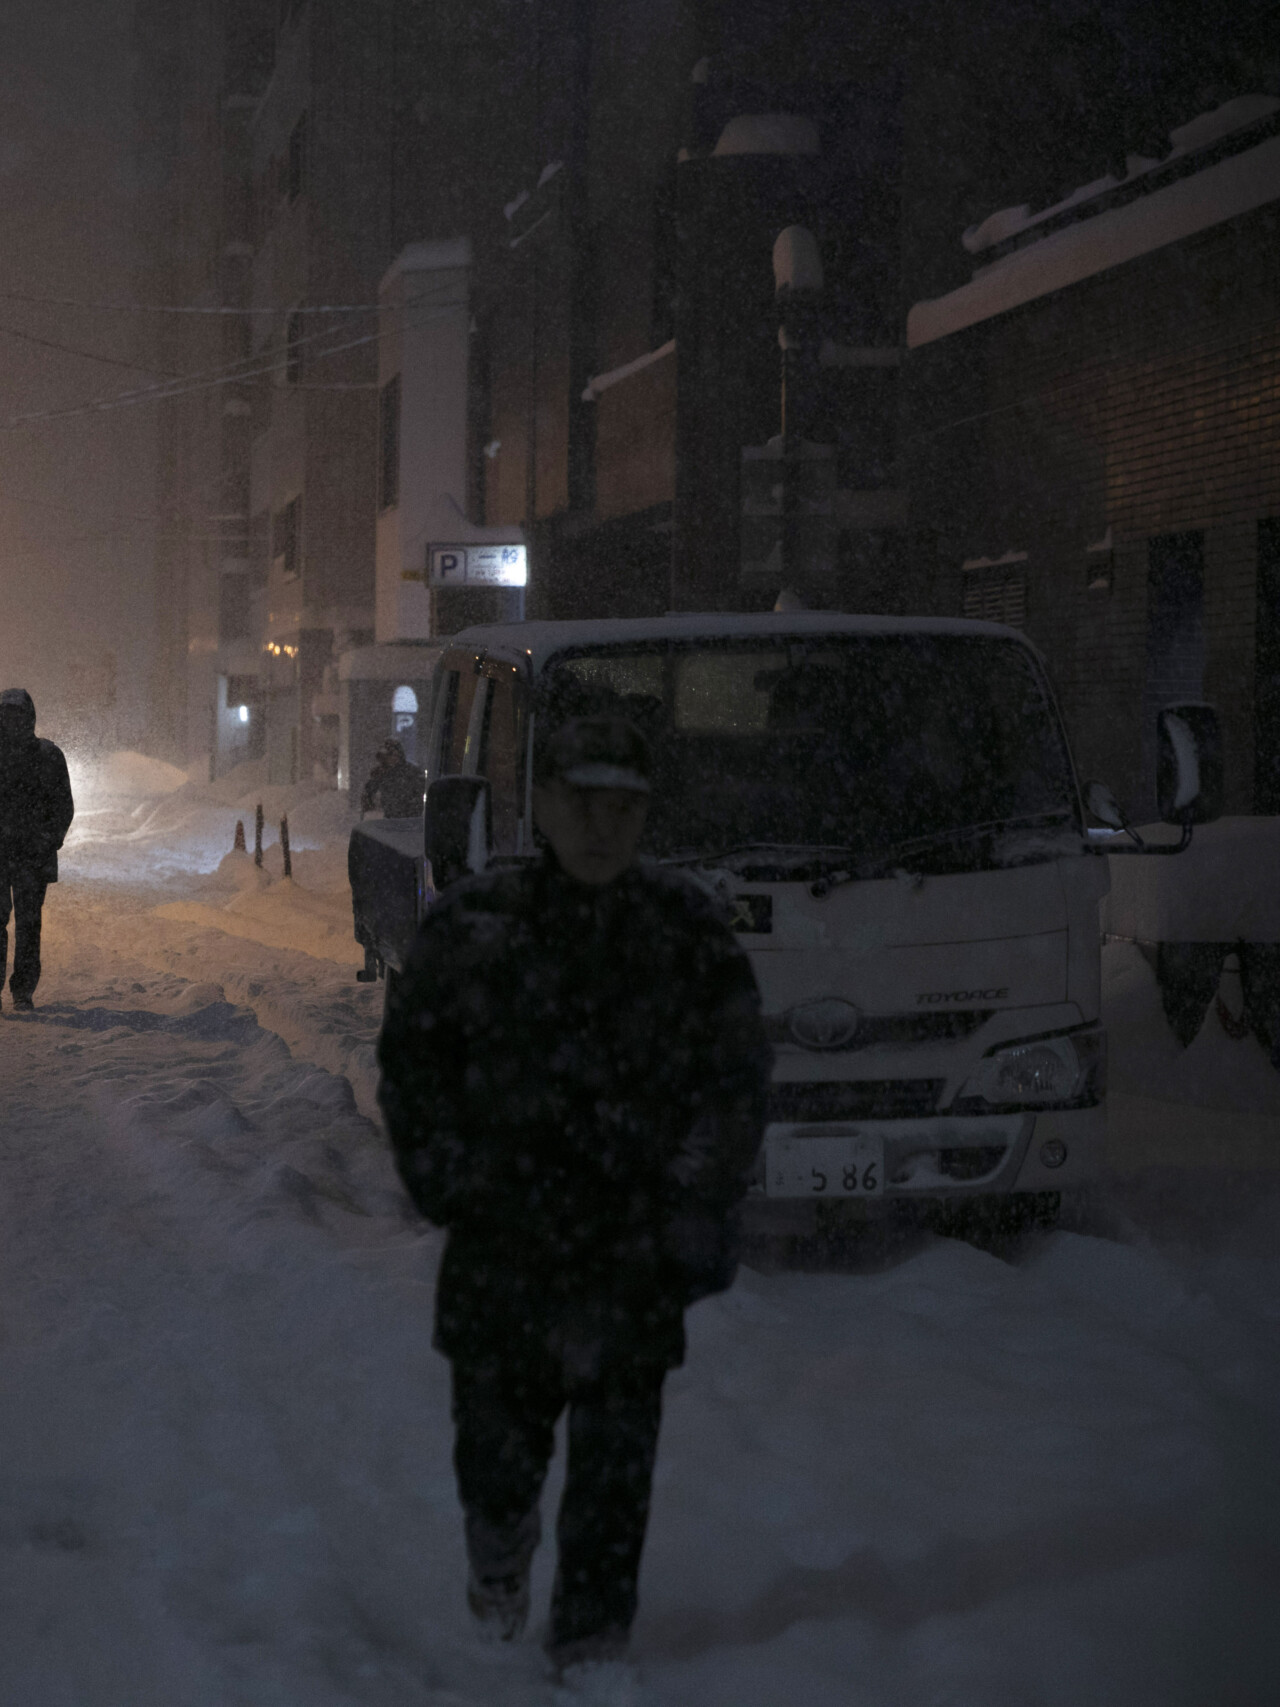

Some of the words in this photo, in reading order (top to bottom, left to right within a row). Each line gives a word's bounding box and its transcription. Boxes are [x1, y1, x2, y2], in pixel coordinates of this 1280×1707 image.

[440, 554, 458, 578] P
[396, 714, 415, 732] P
[917, 988, 1009, 1004] TOYOACE
